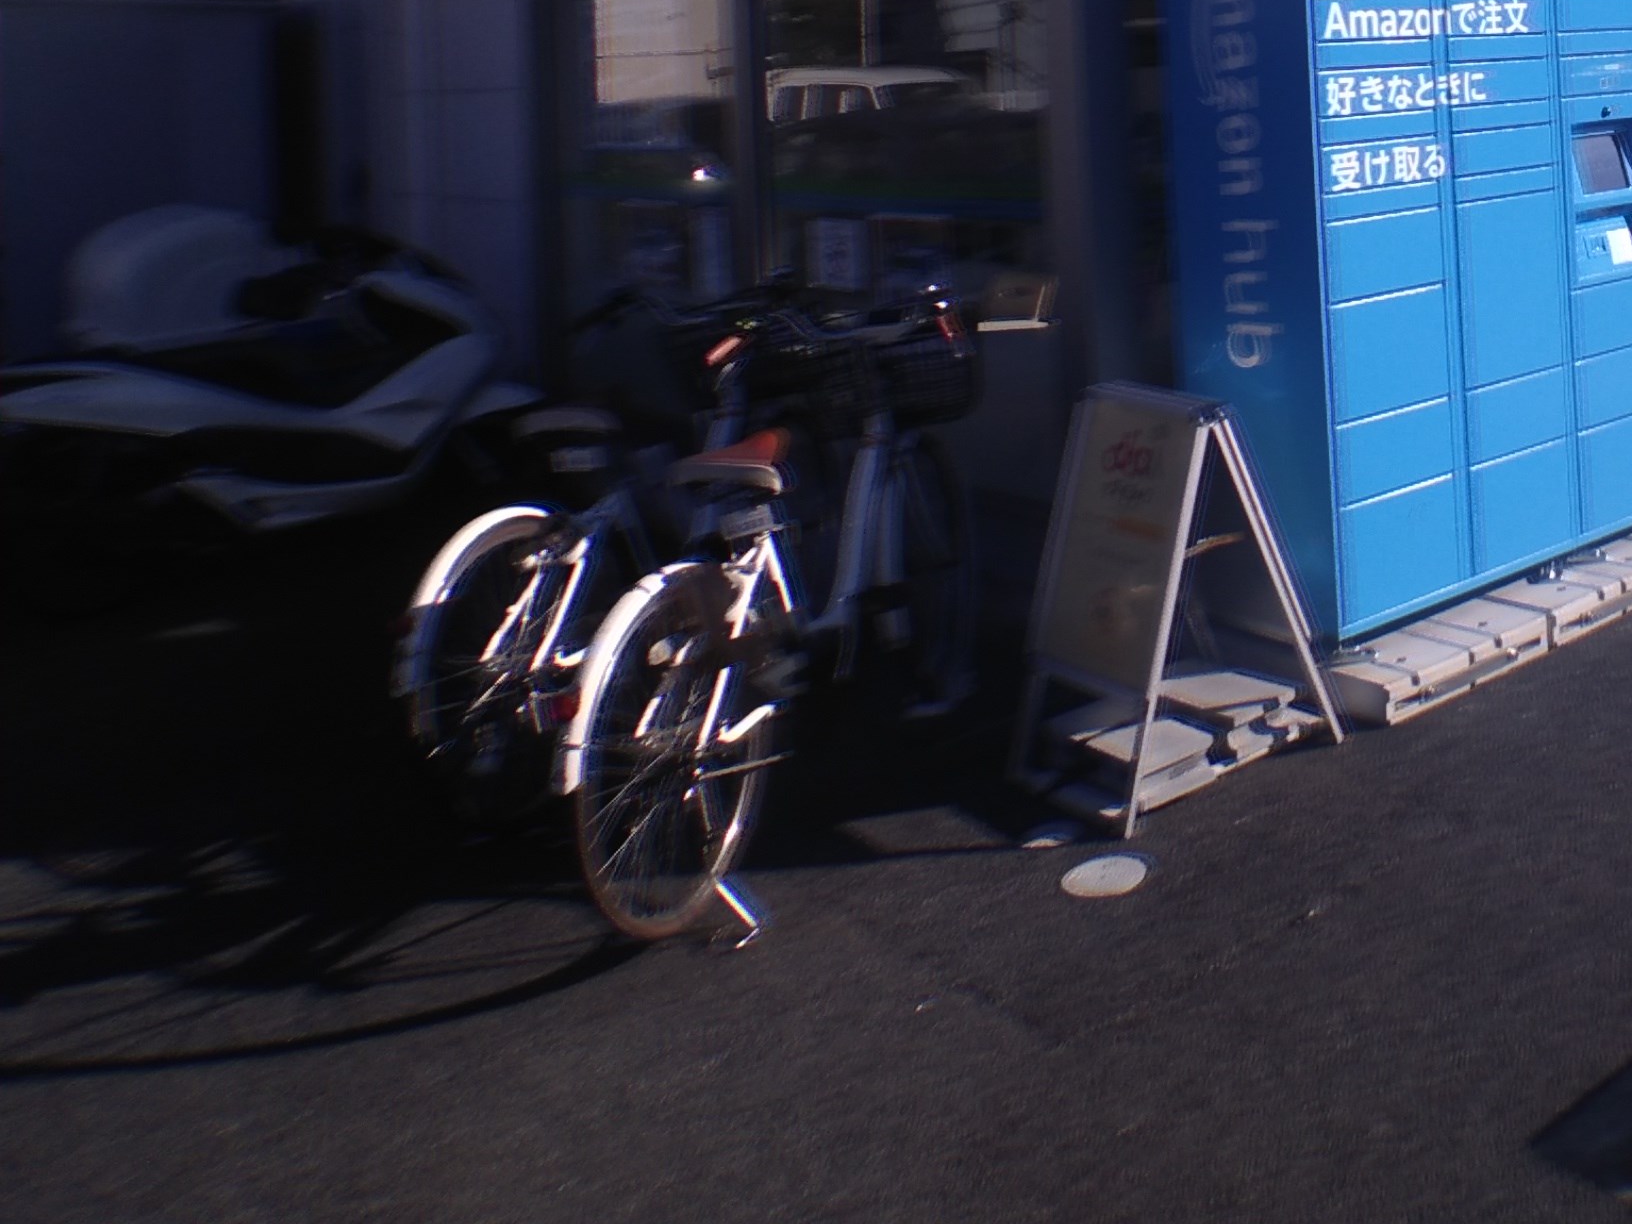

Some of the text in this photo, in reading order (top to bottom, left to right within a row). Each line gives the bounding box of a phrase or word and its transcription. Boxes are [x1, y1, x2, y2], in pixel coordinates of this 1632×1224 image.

[1325, 71, 1487, 116] 好きなときに
[1330, 144, 1446, 192] 受け取る
[1222, 220, 1284, 368] hub
